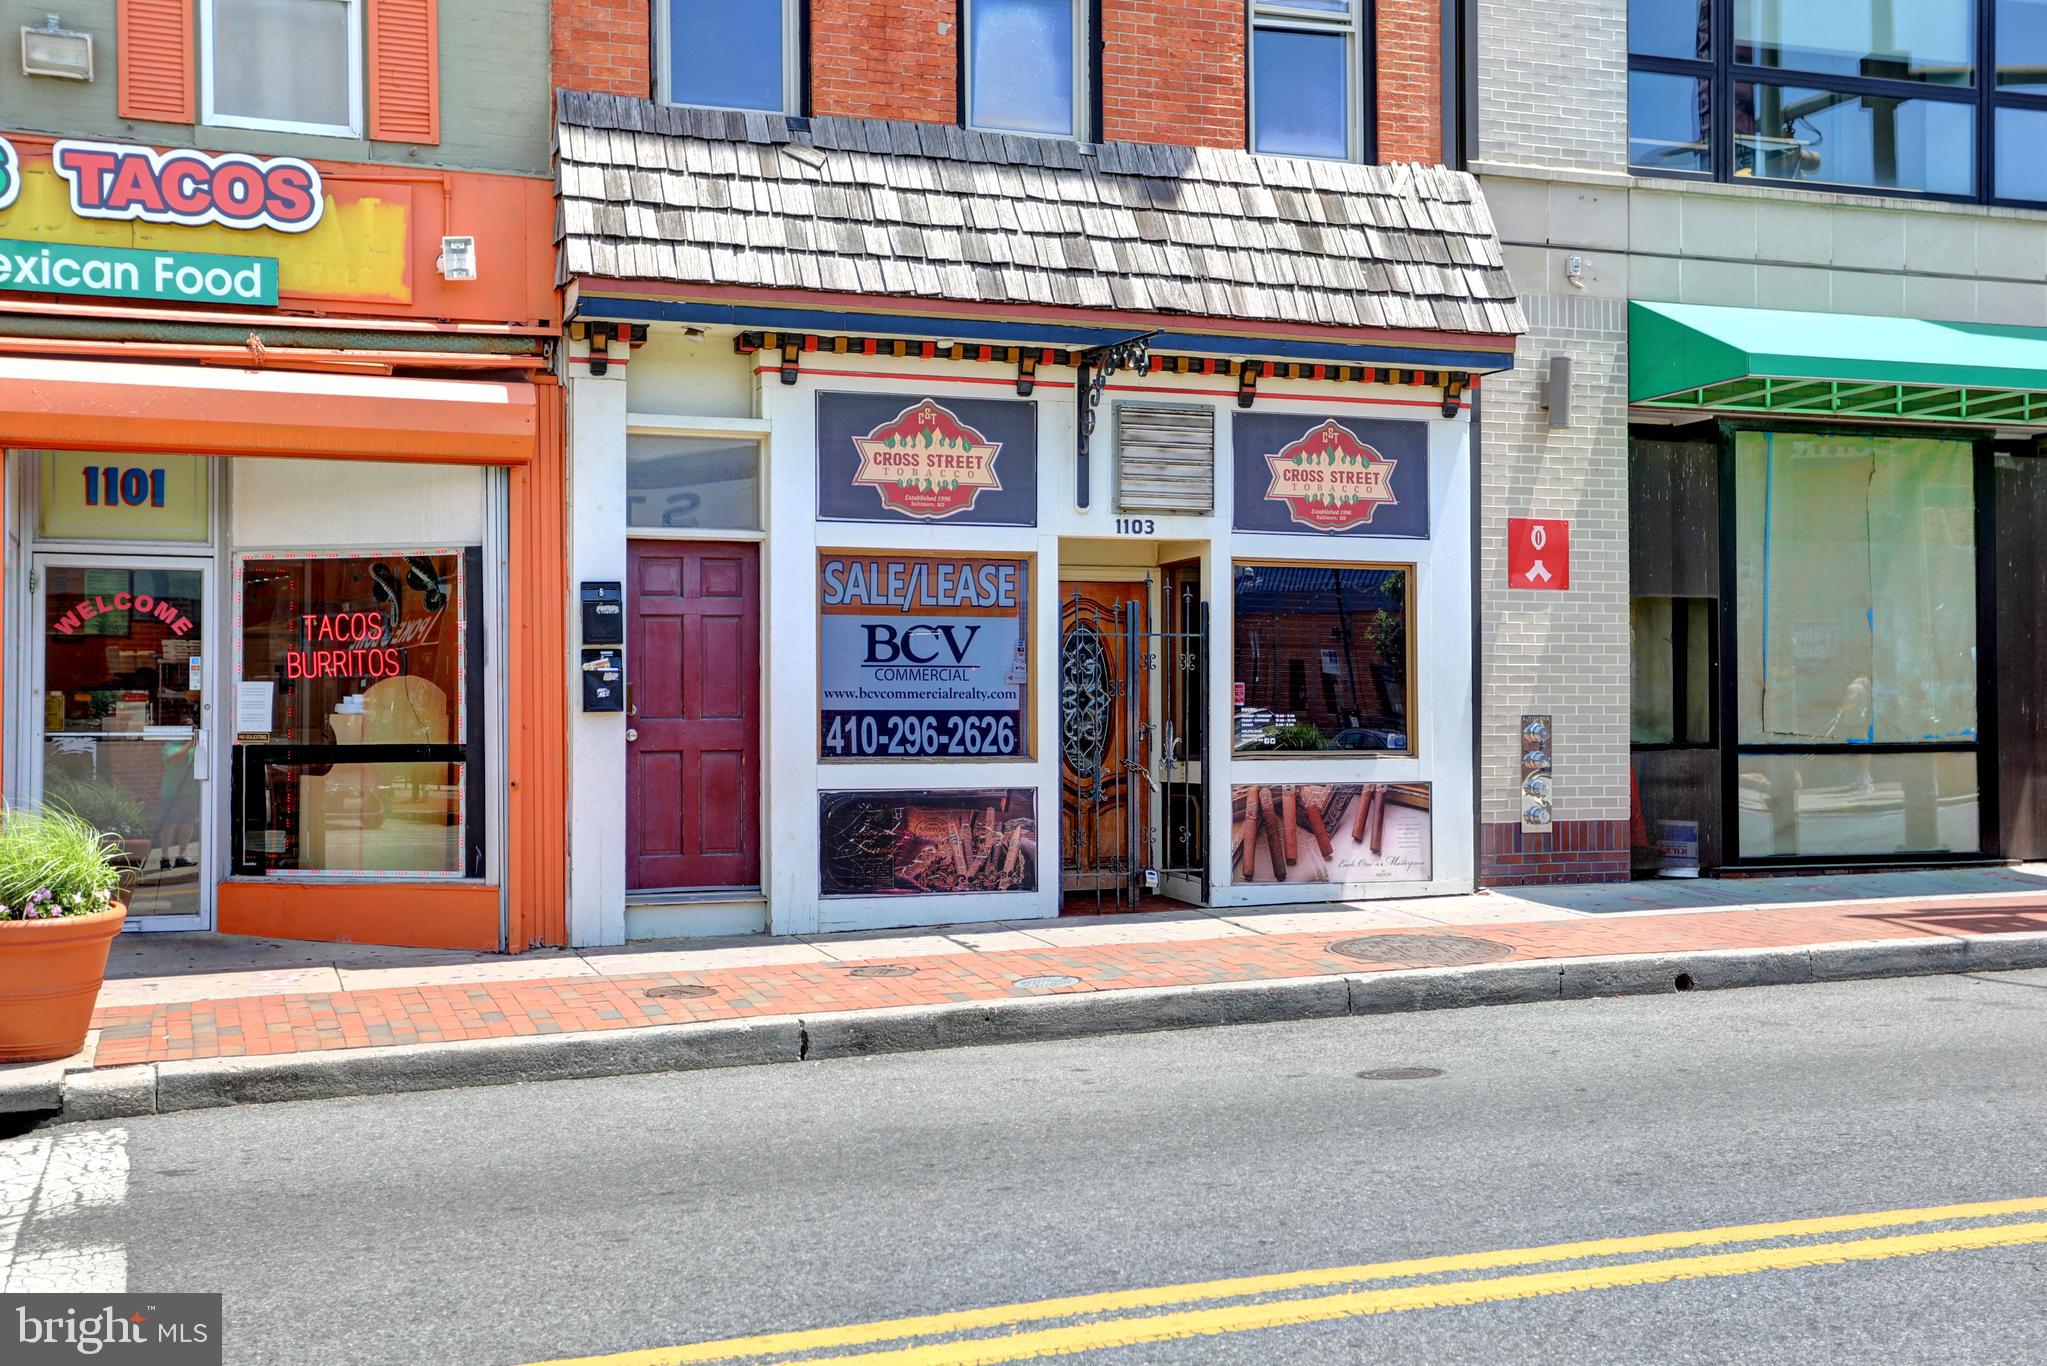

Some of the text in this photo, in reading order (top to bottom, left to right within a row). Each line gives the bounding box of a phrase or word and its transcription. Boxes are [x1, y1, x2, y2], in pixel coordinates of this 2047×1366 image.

[61, 149, 316, 221] TACOS
[155, 257, 262, 299] Food
[873, 452, 984, 470] CROSS STREET
[882, 467, 975, 479] TOBACCO
[1283, 468, 1380, 485] CROSS STREET
[82, 466, 165, 508] 1101
[1291, 483, 1373, 494] TOBACCO
[1115, 518, 1155, 535] 1103
[823, 559, 1016, 613] SALE/LEASE
[54, 591, 193, 637] WELCOME
[302, 612, 383, 642] TACOS
[861, 623, 981, 664] BCV
[287, 648, 401, 680] BURRITOS
[874, 667, 970, 682] COMMERCIAL
[824, 687, 1017, 702] www.bcvcommercialrealty.com
[826, 715, 1015, 754] 410-296-2626
